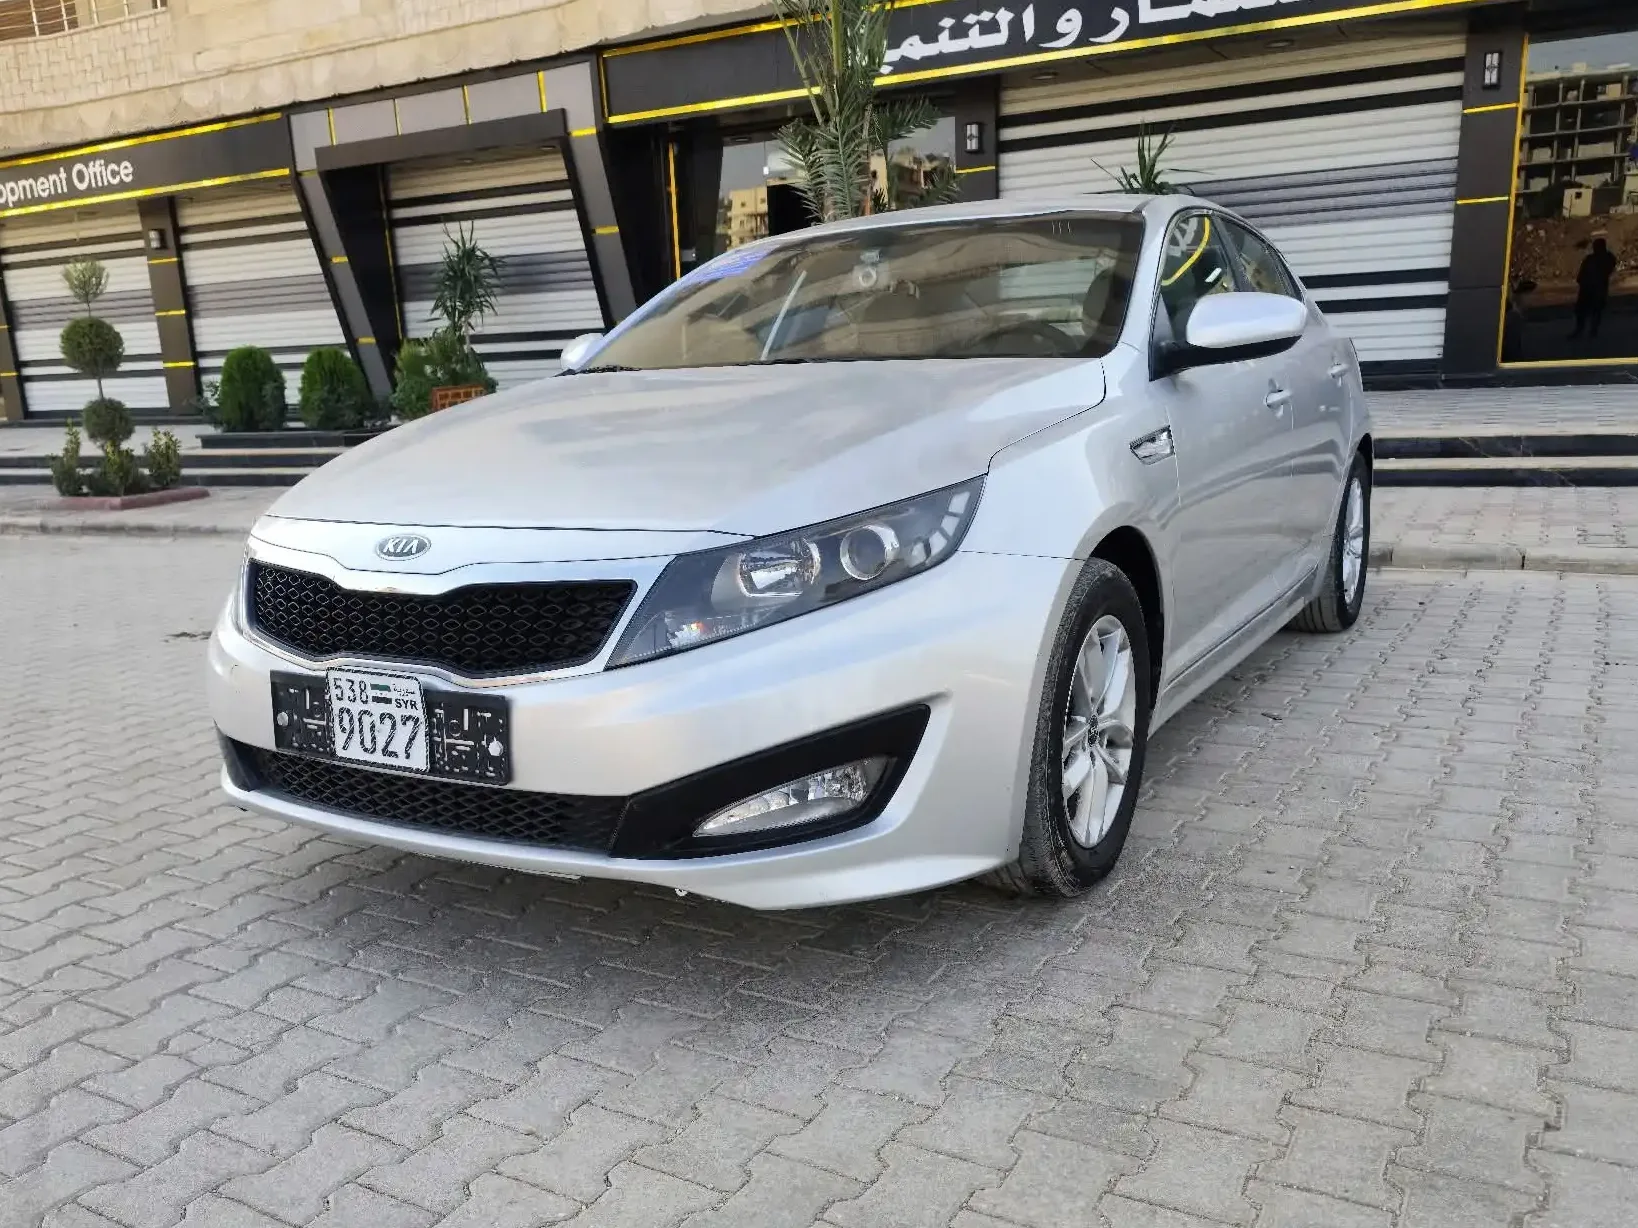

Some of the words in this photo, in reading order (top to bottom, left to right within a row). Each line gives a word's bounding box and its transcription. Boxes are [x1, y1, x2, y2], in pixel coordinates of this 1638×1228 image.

[879, 3, 1083, 75] والتنم
[72, 159, 134, 190] Office
[382, 538, 419, 554] KIA
[333, 677, 369, 705] 538
[394, 698, 418, 711] SYR
[338, 706, 420, 760] 9027
